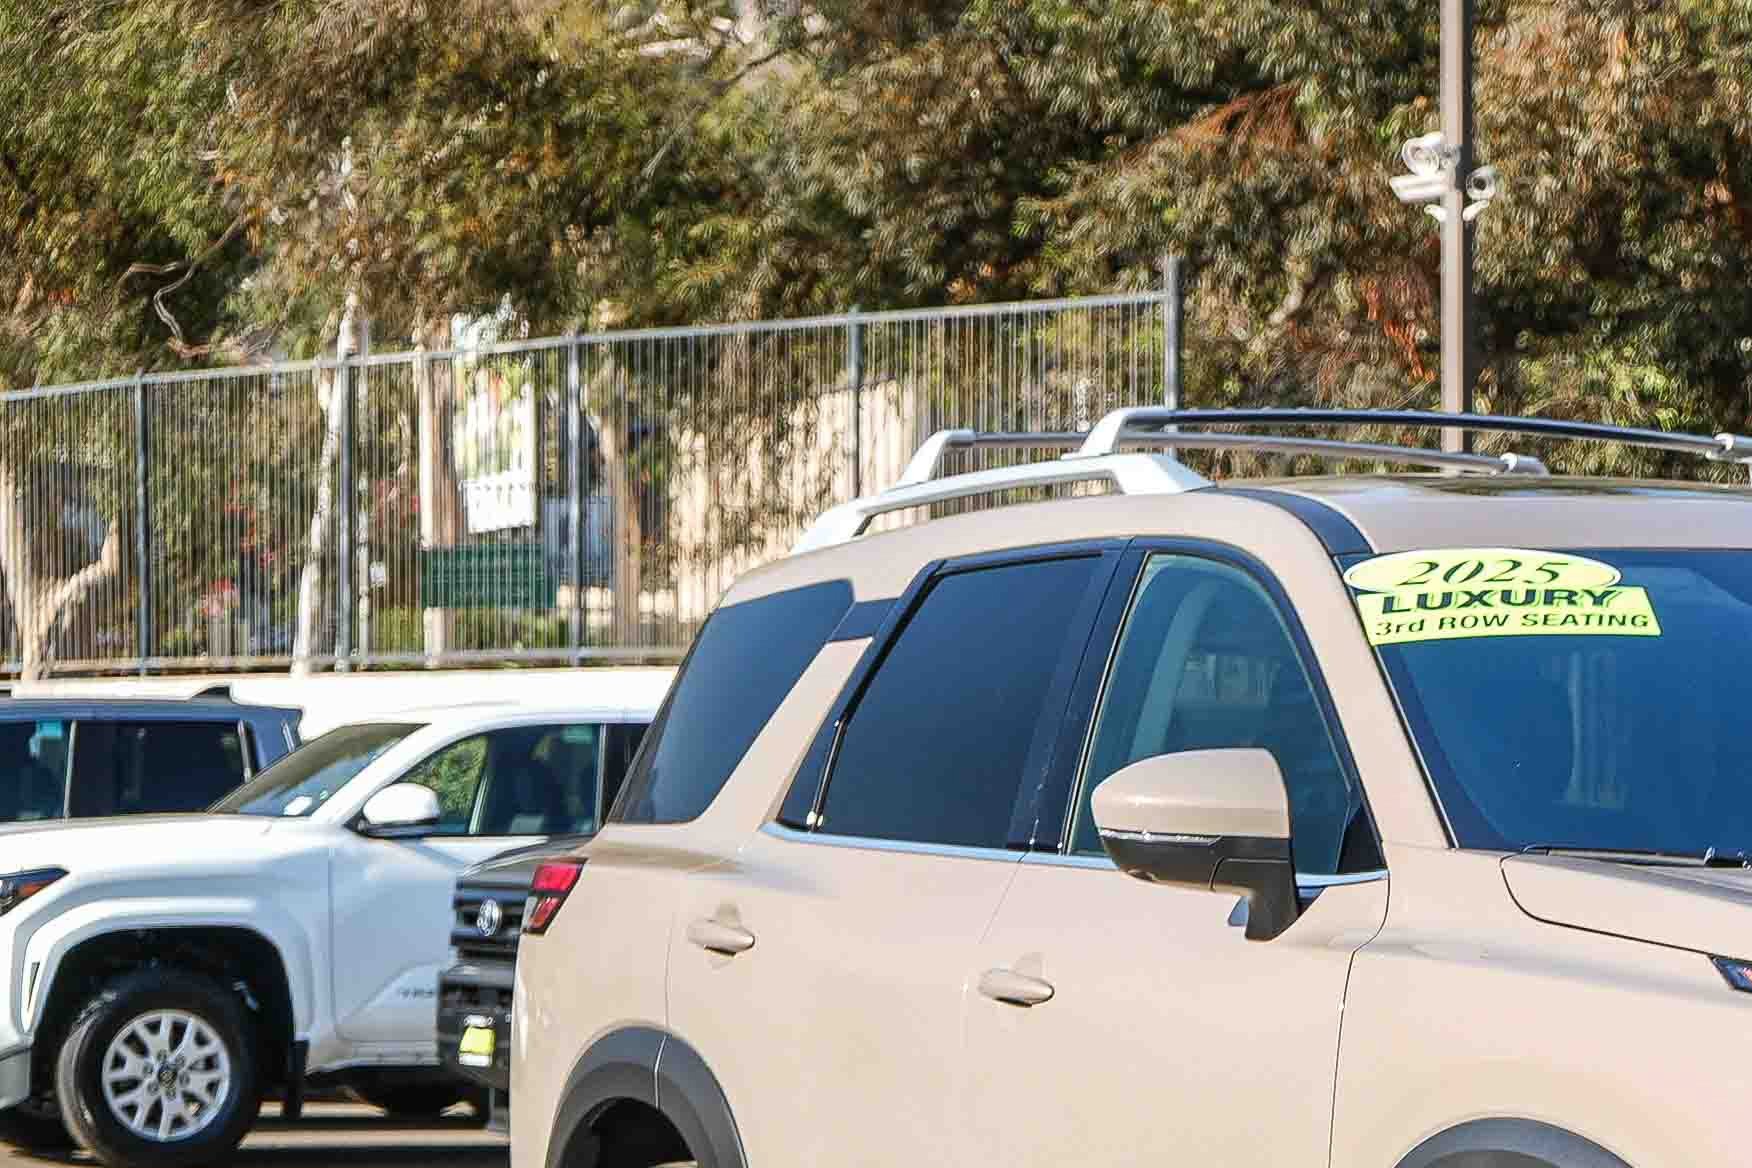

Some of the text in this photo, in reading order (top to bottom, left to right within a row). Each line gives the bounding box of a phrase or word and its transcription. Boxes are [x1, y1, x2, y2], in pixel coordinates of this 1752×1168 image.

[1395, 558, 1570, 587] 2025
[1381, 588, 1620, 615] LUXURY
[1375, 612, 1649, 636] 3rd ROW SEATING
